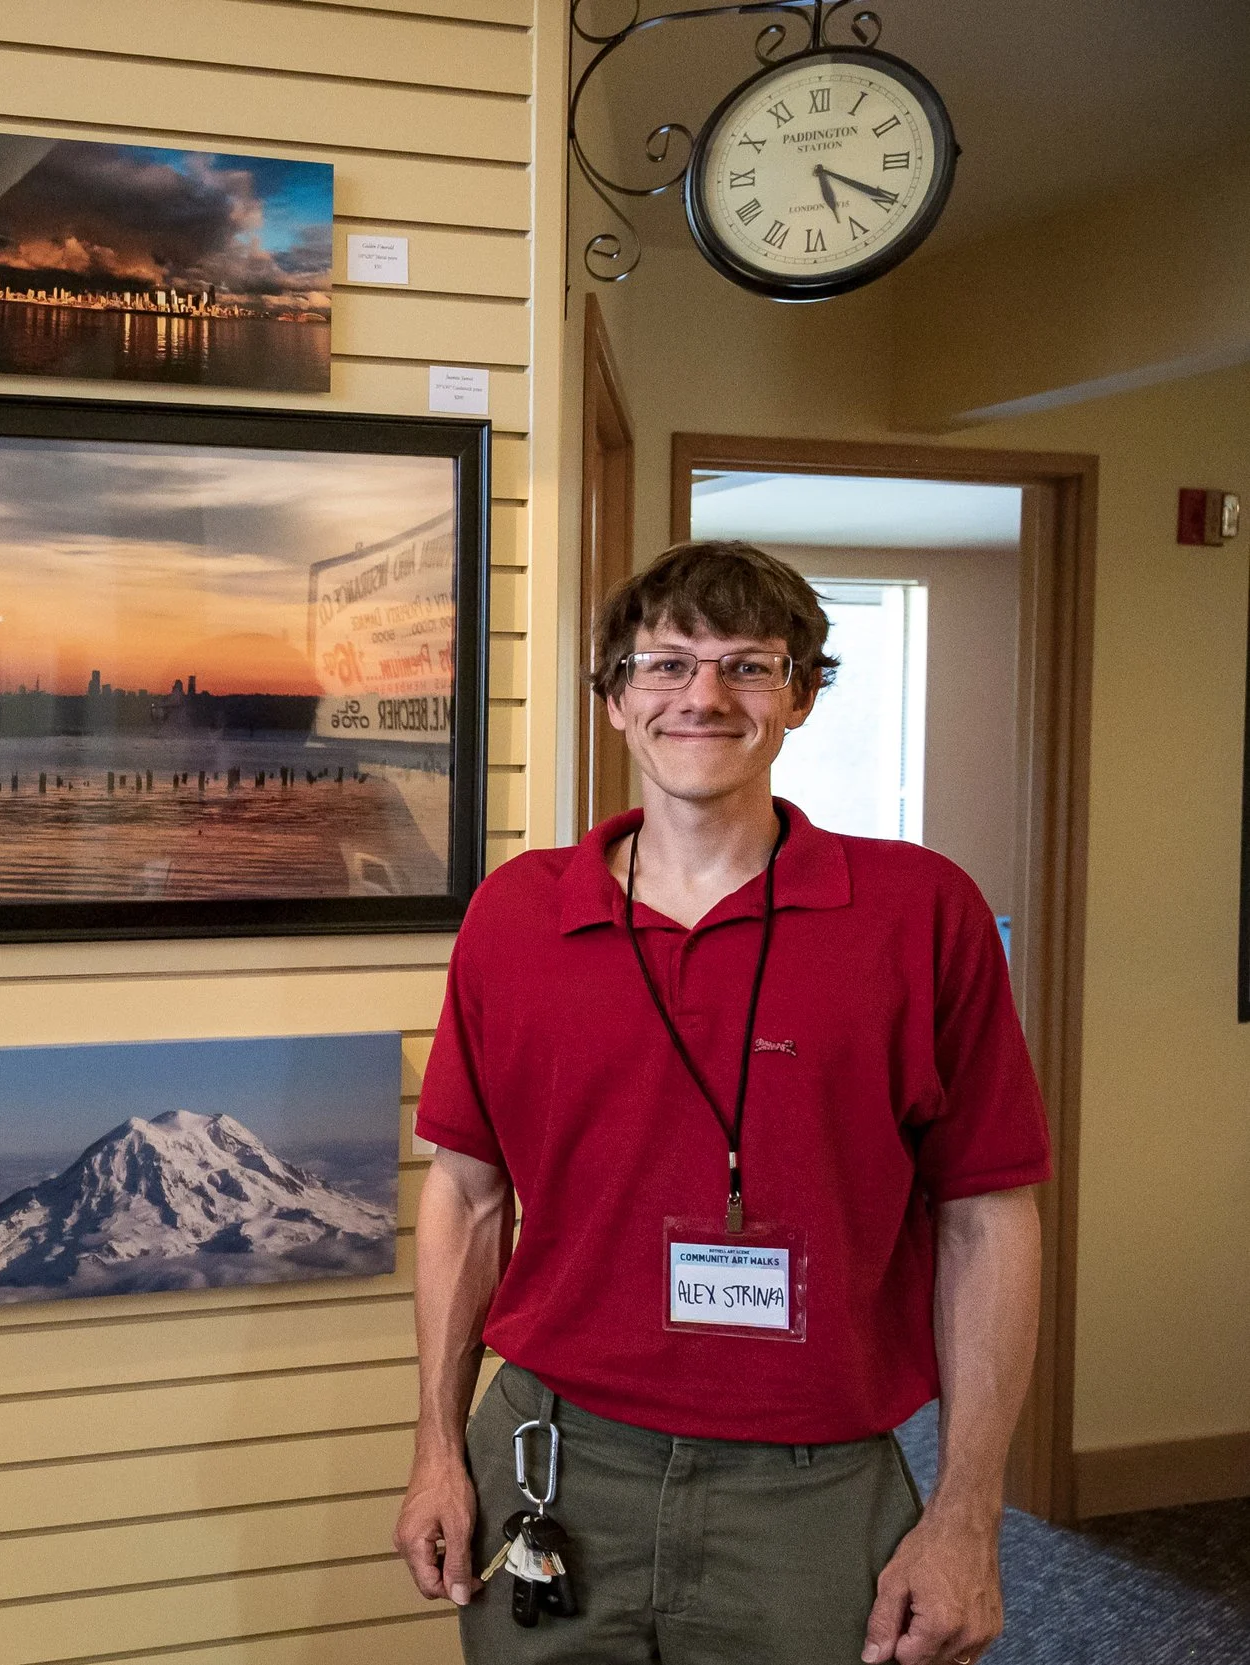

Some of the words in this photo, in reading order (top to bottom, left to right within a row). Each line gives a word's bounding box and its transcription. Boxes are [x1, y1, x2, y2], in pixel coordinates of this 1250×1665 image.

[808, 87, 831, 114] XII
[848, 91, 868, 116] I
[767, 100, 794, 129] XI
[872, 115, 901, 138] II
[738, 132, 767, 154] X
[783, 125, 859, 144] PADDINGTON
[797, 141, 843, 153] STATION
[882, 151, 910, 172] III
[729, 168, 755, 189] IX
[736, 198, 763, 226] VIII
[789, 203, 825, 213] LONDON
[762, 220, 791, 249] VII
[804, 228, 827, 253] VI
[849, 216, 869, 241] V
[680, 1253, 729, 1264] COMMUNITY
[732, 1256, 748, 1265] ART
[750, 1257, 780, 1266] WALKS
[678, 1280, 716, 1304] ALEX
[723, 1284, 784, 1309] STRINKA
